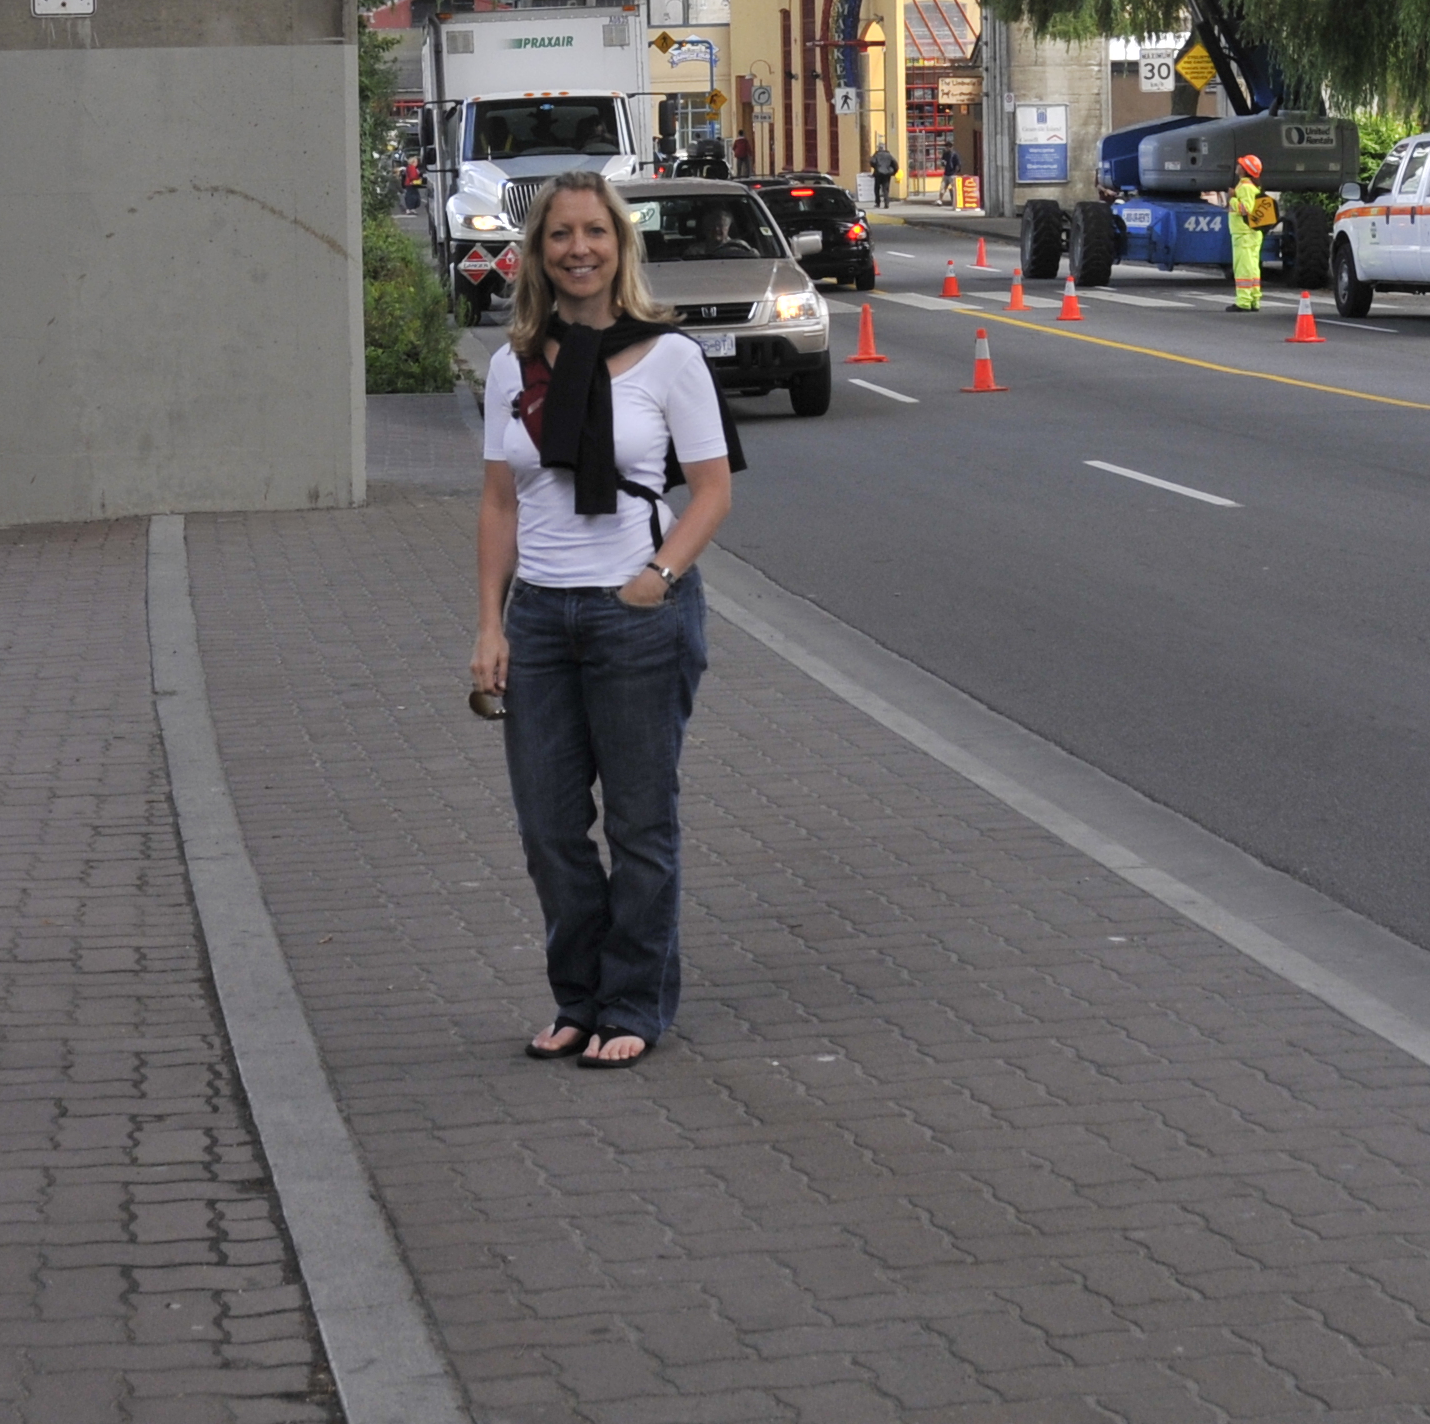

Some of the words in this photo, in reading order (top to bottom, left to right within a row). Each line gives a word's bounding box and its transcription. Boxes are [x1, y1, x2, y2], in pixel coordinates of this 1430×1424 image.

[523, 36, 573, 48] PRAXAIR
[834, 4, 849, 88] MARKET
[1144, 63, 1171, 80] 30
[1305, 127, 1330, 135] United
[1305, 136, 1334, 145] Rentals
[1251, 199, 1272, 225] SLOW
[1184, 216, 1222, 232] 4X4
